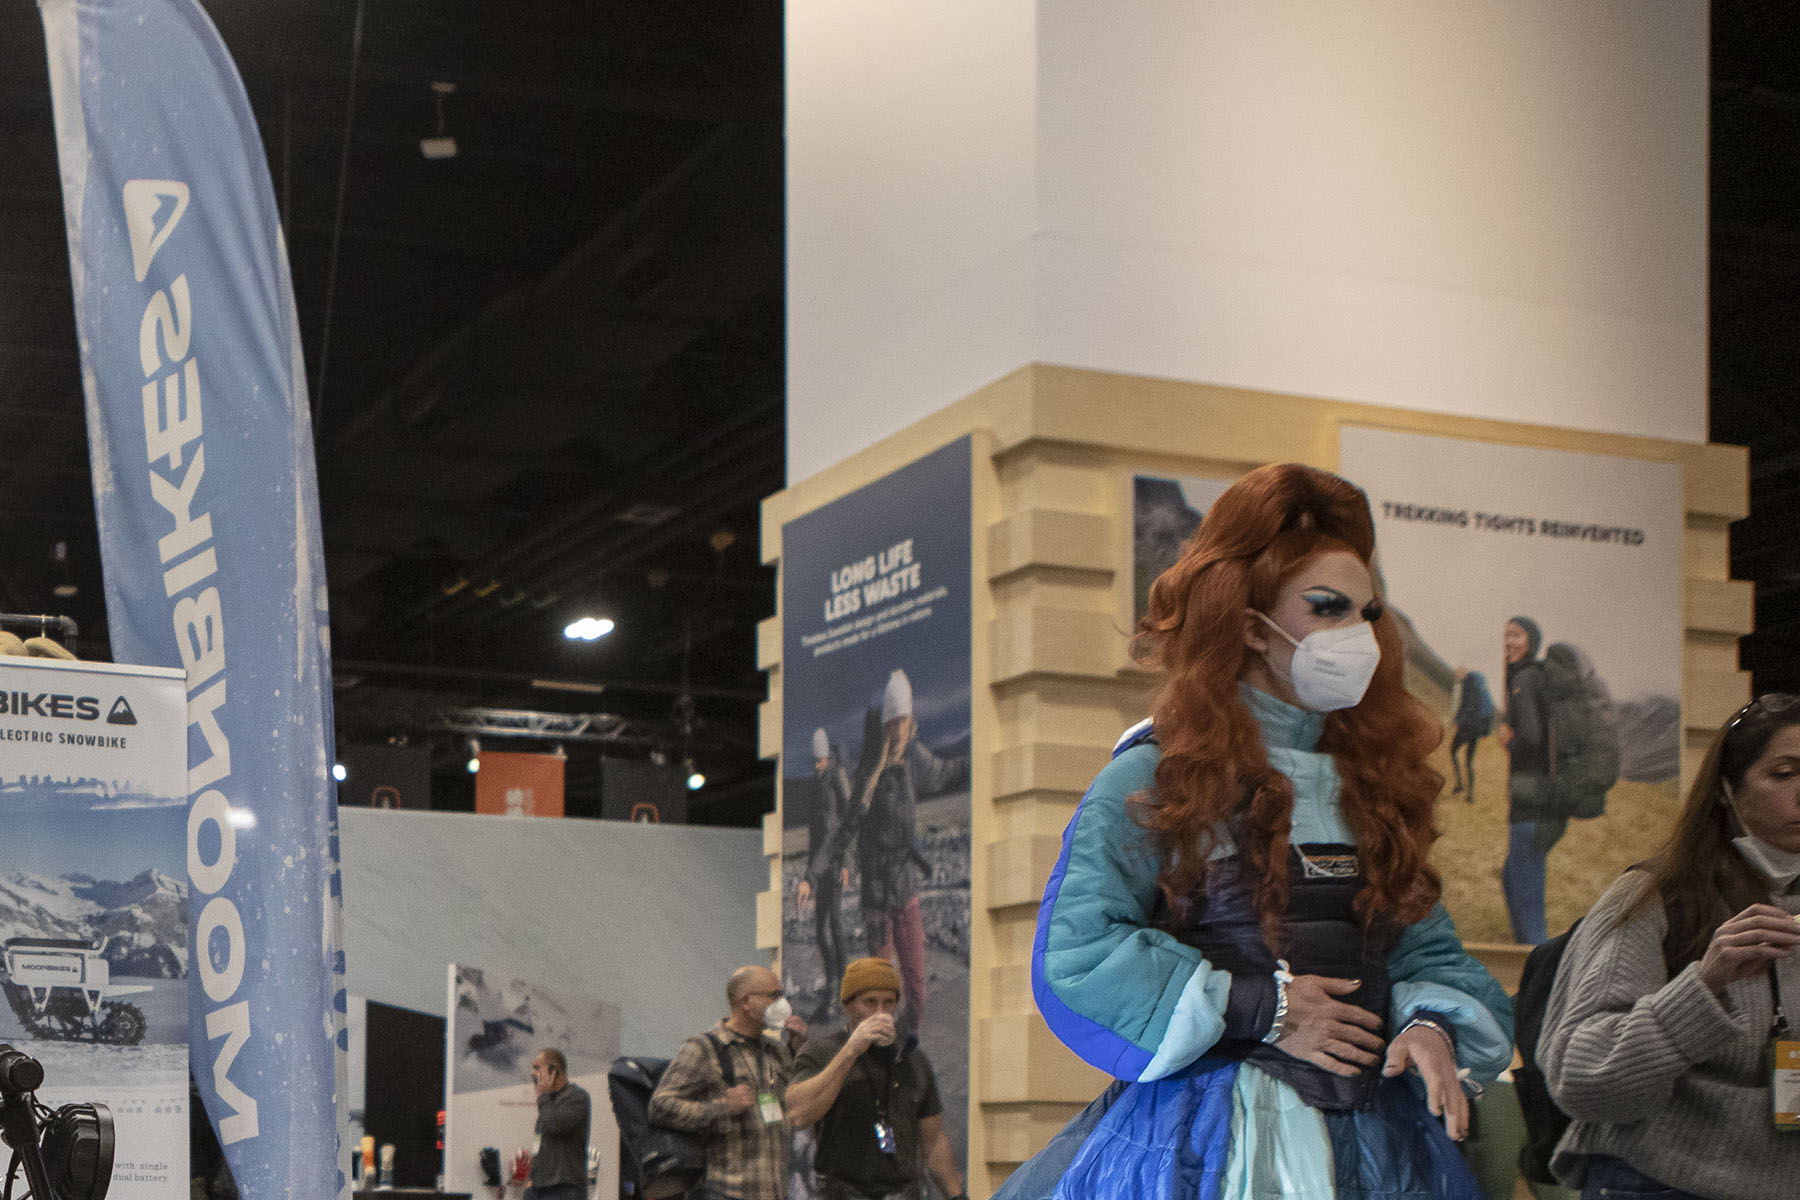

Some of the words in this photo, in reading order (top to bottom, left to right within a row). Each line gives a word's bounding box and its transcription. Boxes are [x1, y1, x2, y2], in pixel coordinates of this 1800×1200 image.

[1383, 501, 1468, 528] TREKKING
[1474, 511, 1536, 535] TIGHTS
[1541, 519, 1646, 546] REINVENTED
[831, 556, 876, 593] LONG
[878, 538, 914, 575] LIFE
[824, 588, 861, 622] LESS
[863, 562, 921, 606] WASTE
[59, 732, 127, 749] SNOWBIKE
[22, 963, 71, 972] MOONBIKES
[140, 1162, 168, 1172] single
[135, 1174, 168, 1183] battery
